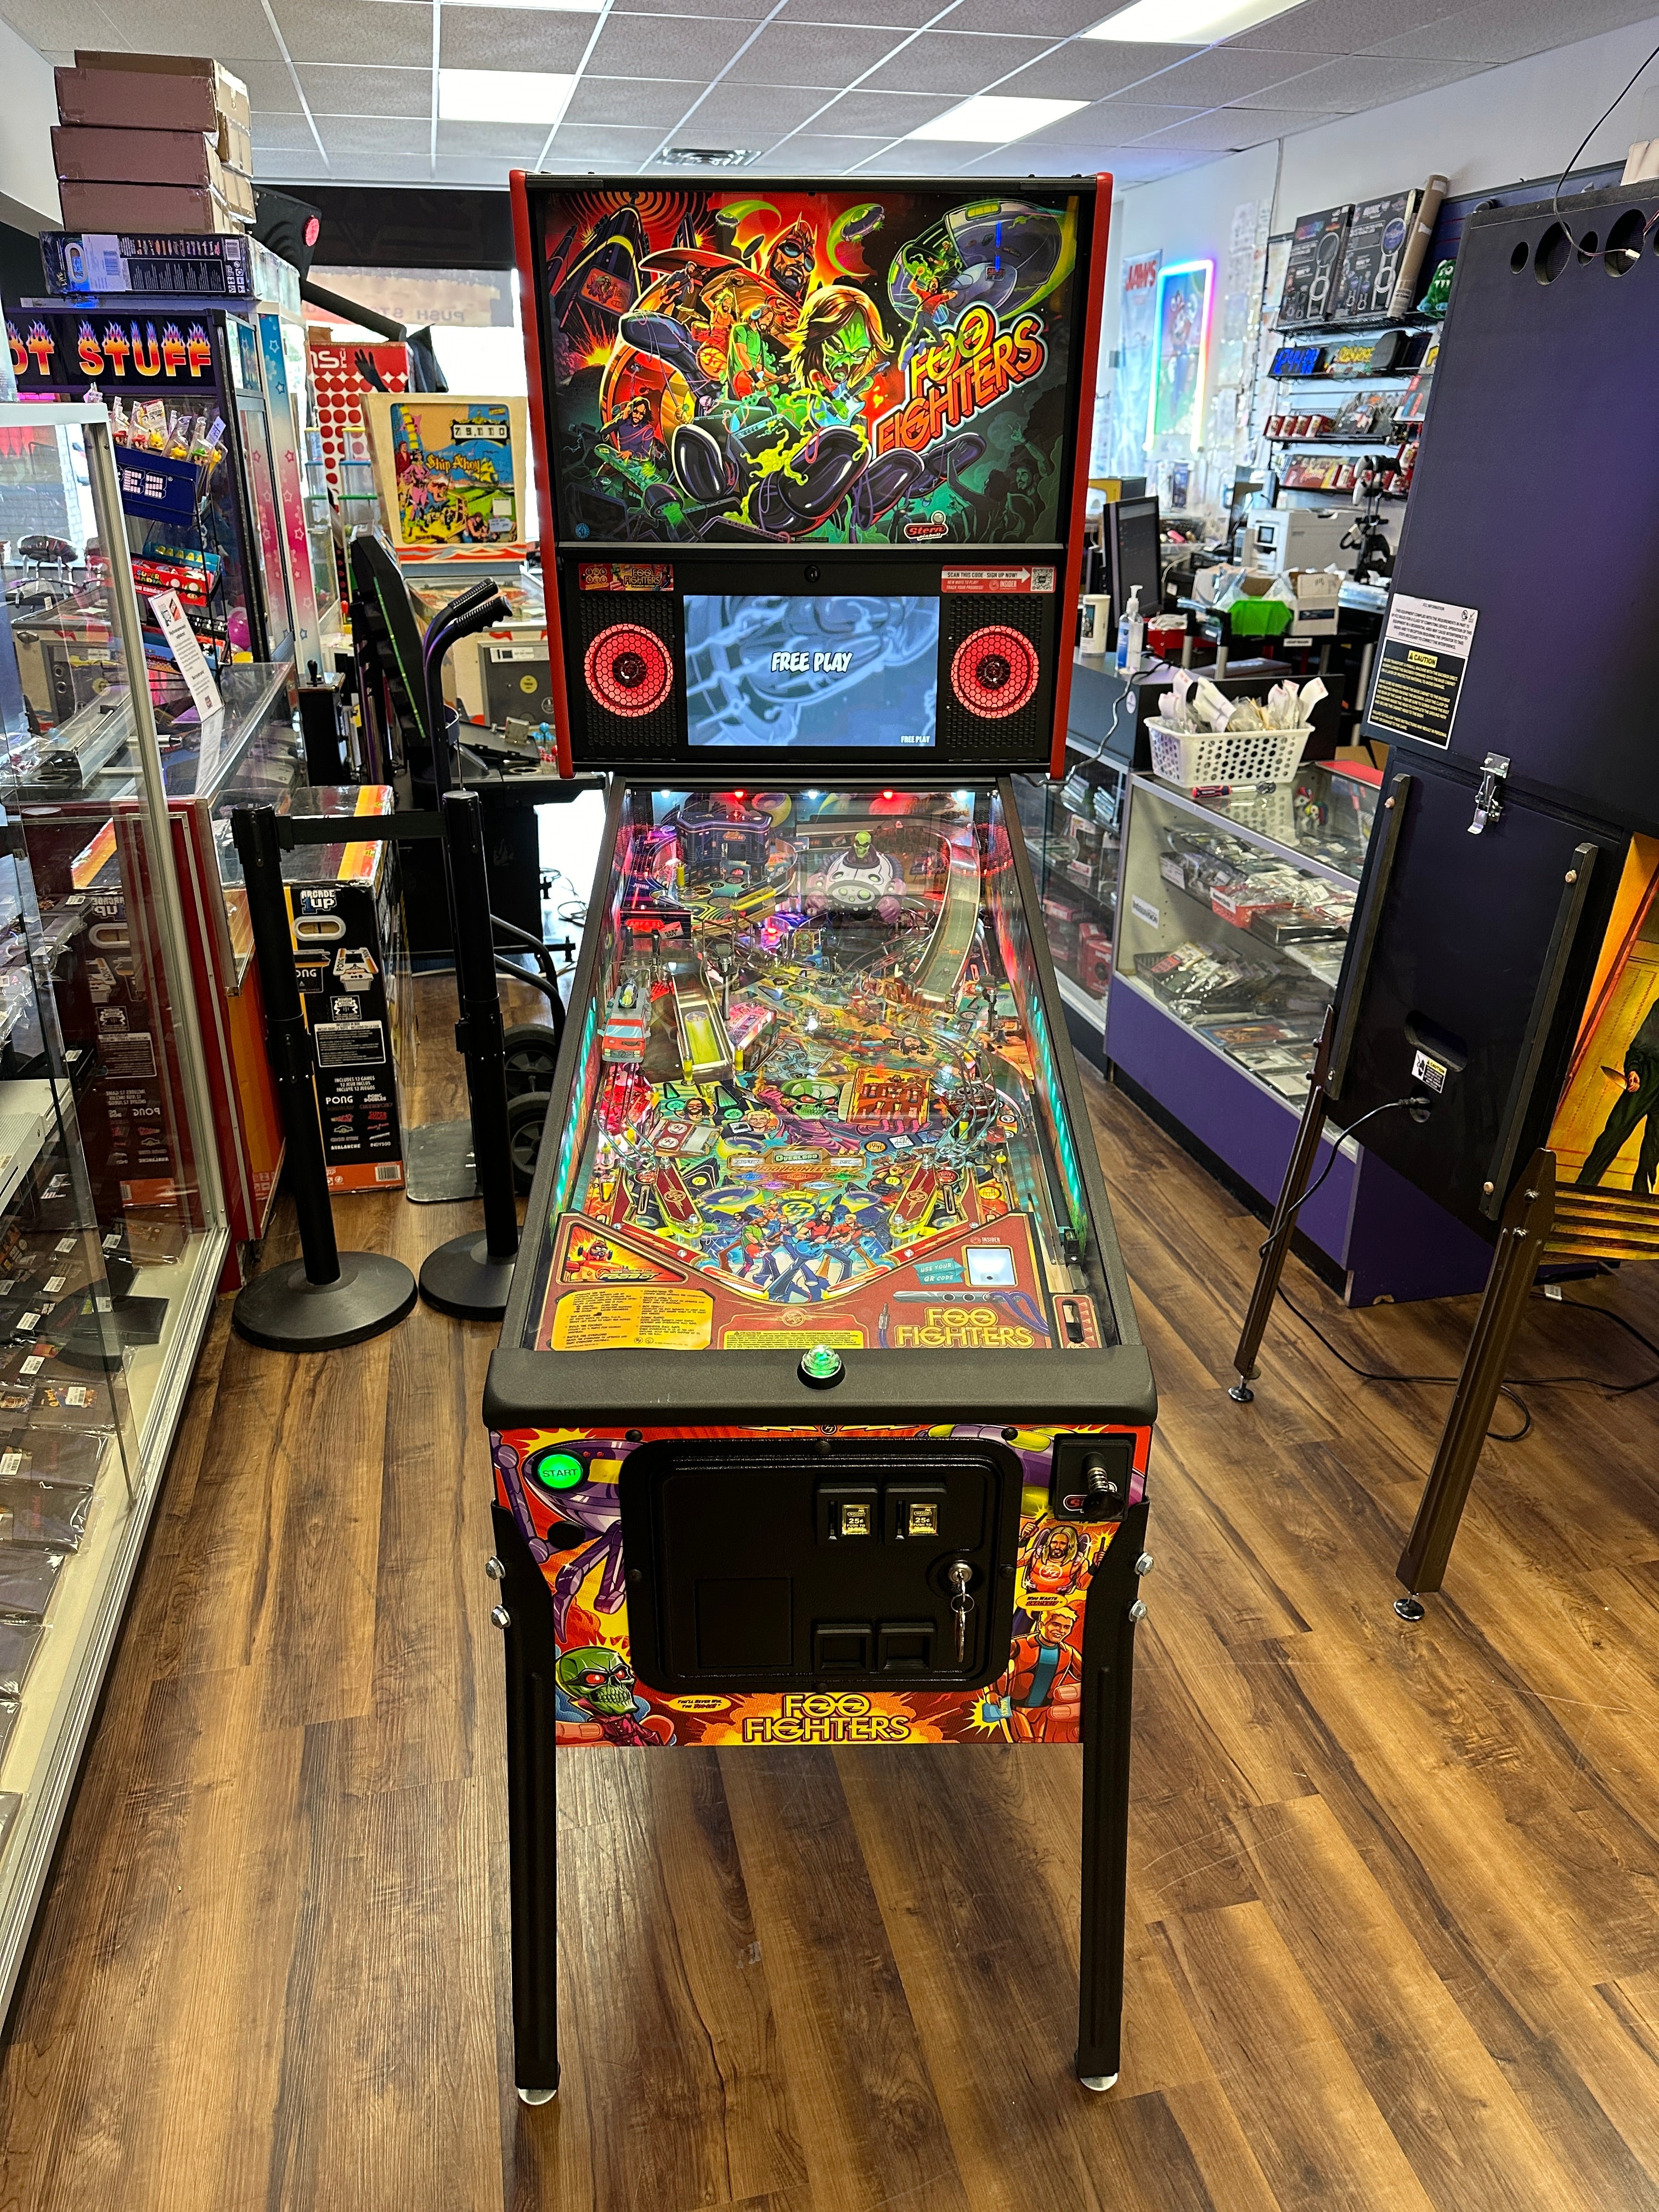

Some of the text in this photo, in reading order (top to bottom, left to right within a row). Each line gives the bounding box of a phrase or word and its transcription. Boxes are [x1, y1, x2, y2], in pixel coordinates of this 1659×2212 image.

[7, 319, 212, 377] OT STUFF
[911, 307, 994, 399] FOO
[878, 318, 1043, 455] FIGHTERS
[426, 454, 480, 474] Ship Ahoy
[123, 469, 164, 498] EZ
[907, 526, 945, 535] Stern
[136, 569, 160, 580] SUPER
[632, 568, 652, 577] FOO
[624, 575, 662, 585] FIGHTERS
[771, 651, 853, 673] FREE PLAY
[1413, 654, 1436, 665] CAUTION
[301, 889, 336, 899] ARCADE
[296, 969, 318, 978] ONG
[1430, 1062, 1445, 1074] CAUTION
[325, 1095, 353, 1105] PONG
[775, 1153, 819, 1162] OVERLORD
[926, 1307, 997, 1327] FOO
[896, 1325, 1035, 1348] FIGHTERS
[542, 1469, 578, 1477] START
[784, 1694, 870, 1718] FOO
[744, 1716, 911, 1742] FIGHTERS
